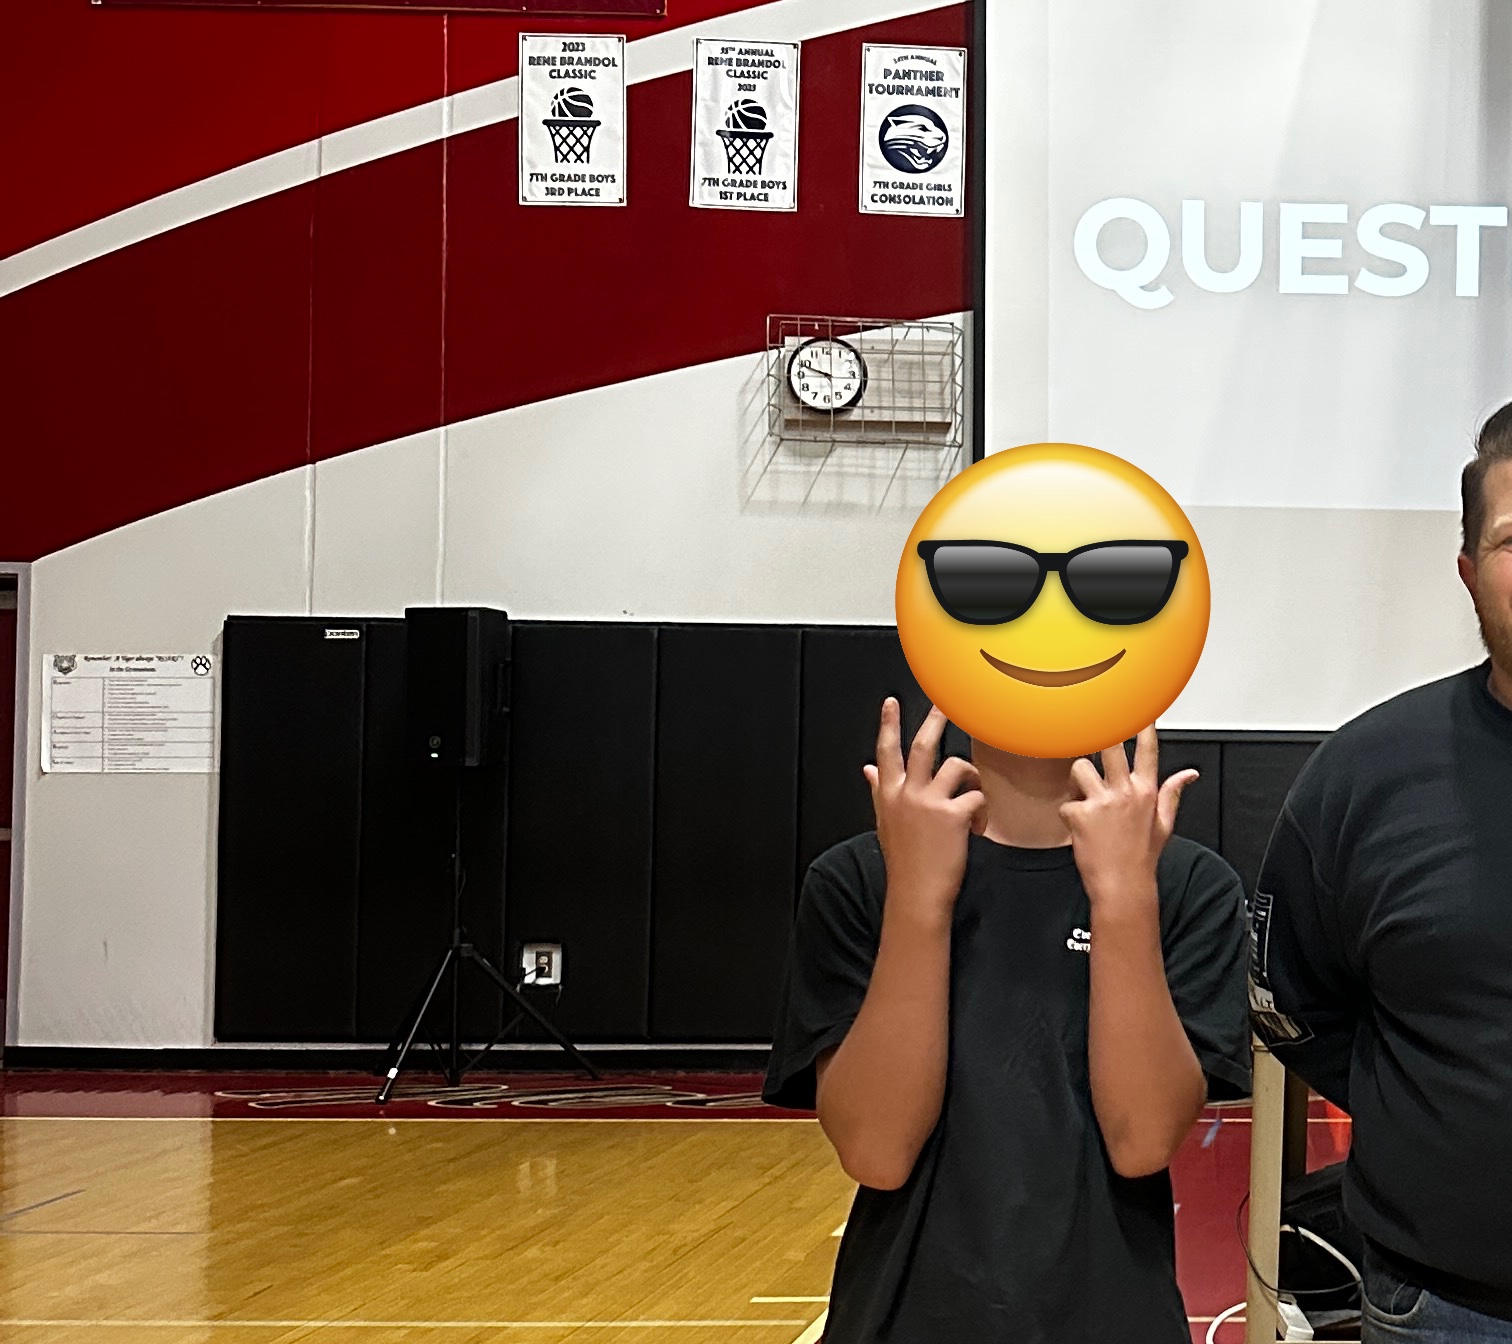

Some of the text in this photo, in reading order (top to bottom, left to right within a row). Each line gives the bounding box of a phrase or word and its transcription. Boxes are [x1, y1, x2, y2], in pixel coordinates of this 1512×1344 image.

[561, 41, 586, 53] 2023
[737, 48, 775, 57] ANNUAL
[528, 56, 618, 67] RENE BRANDOL
[707, 56, 786, 69] RENE BRANDOL
[548, 68, 597, 79] CLASSIC
[726, 69, 769, 80] CLASSIC
[883, 67, 945, 82] PANTHER
[867, 82, 961, 98] TOURNAMENT
[529, 172, 616, 183] 7TH GRADE BOYS
[701, 177, 787, 190] 7TH GRADE BOYS
[872, 180, 953, 192] 7TH GRADE GIRLS
[544, 186, 601, 197] 3RD PLACE
[719, 190, 769, 202] 1ST PLACE
[870, 193, 954, 206] CONSOLATION
[810, 349, 819, 359] 11
[800, 359, 812, 368] 10
[797, 370, 805, 379] 9
[801, 382, 810, 391] 8
[843, 382, 852, 391] 4
[811, 391, 818, 400] 7
[823, 394, 831, 404] 6
[834, 391, 842, 400] 5
